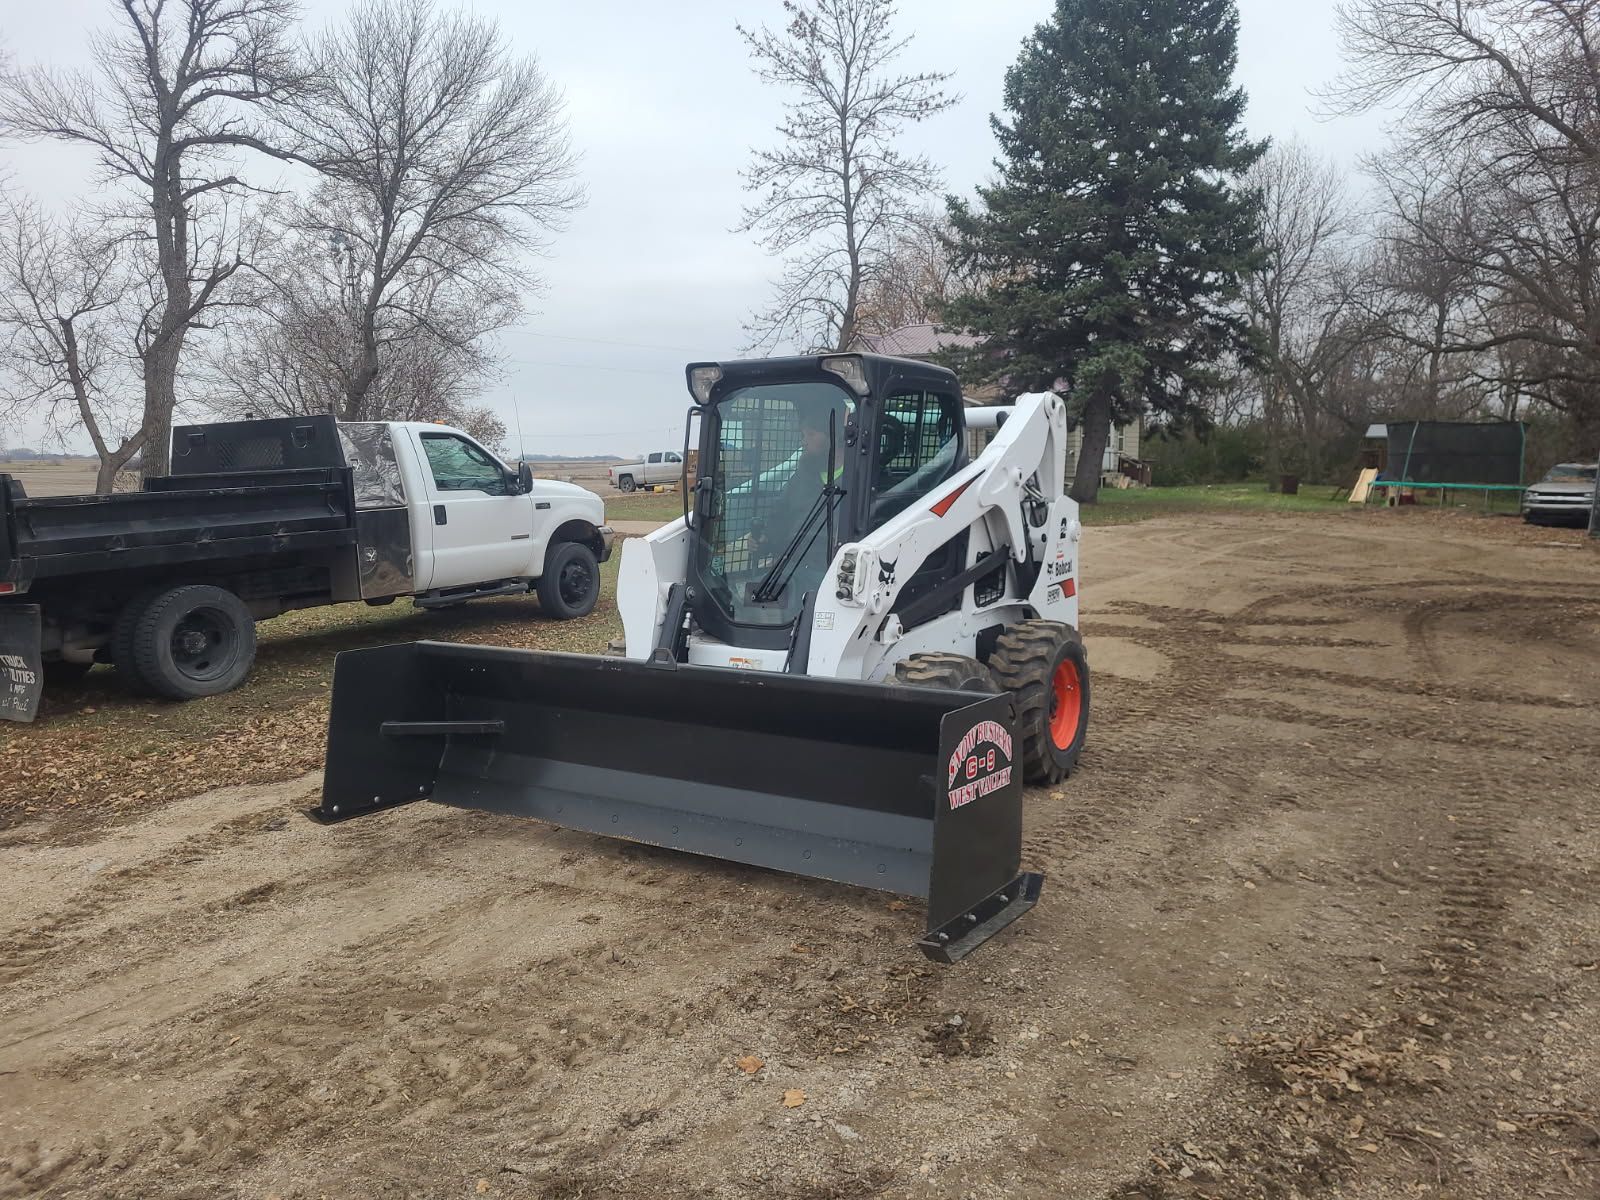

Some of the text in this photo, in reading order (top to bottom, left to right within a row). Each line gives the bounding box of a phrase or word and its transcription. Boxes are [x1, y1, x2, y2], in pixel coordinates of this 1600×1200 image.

[1055, 559, 1073, 577] Bobcat
[0, 655, 27, 668] TRUCK
[948, 720, 1013, 790] SNOW BUSTERS
[948, 765, 1013, 810] WEST VALLEY
